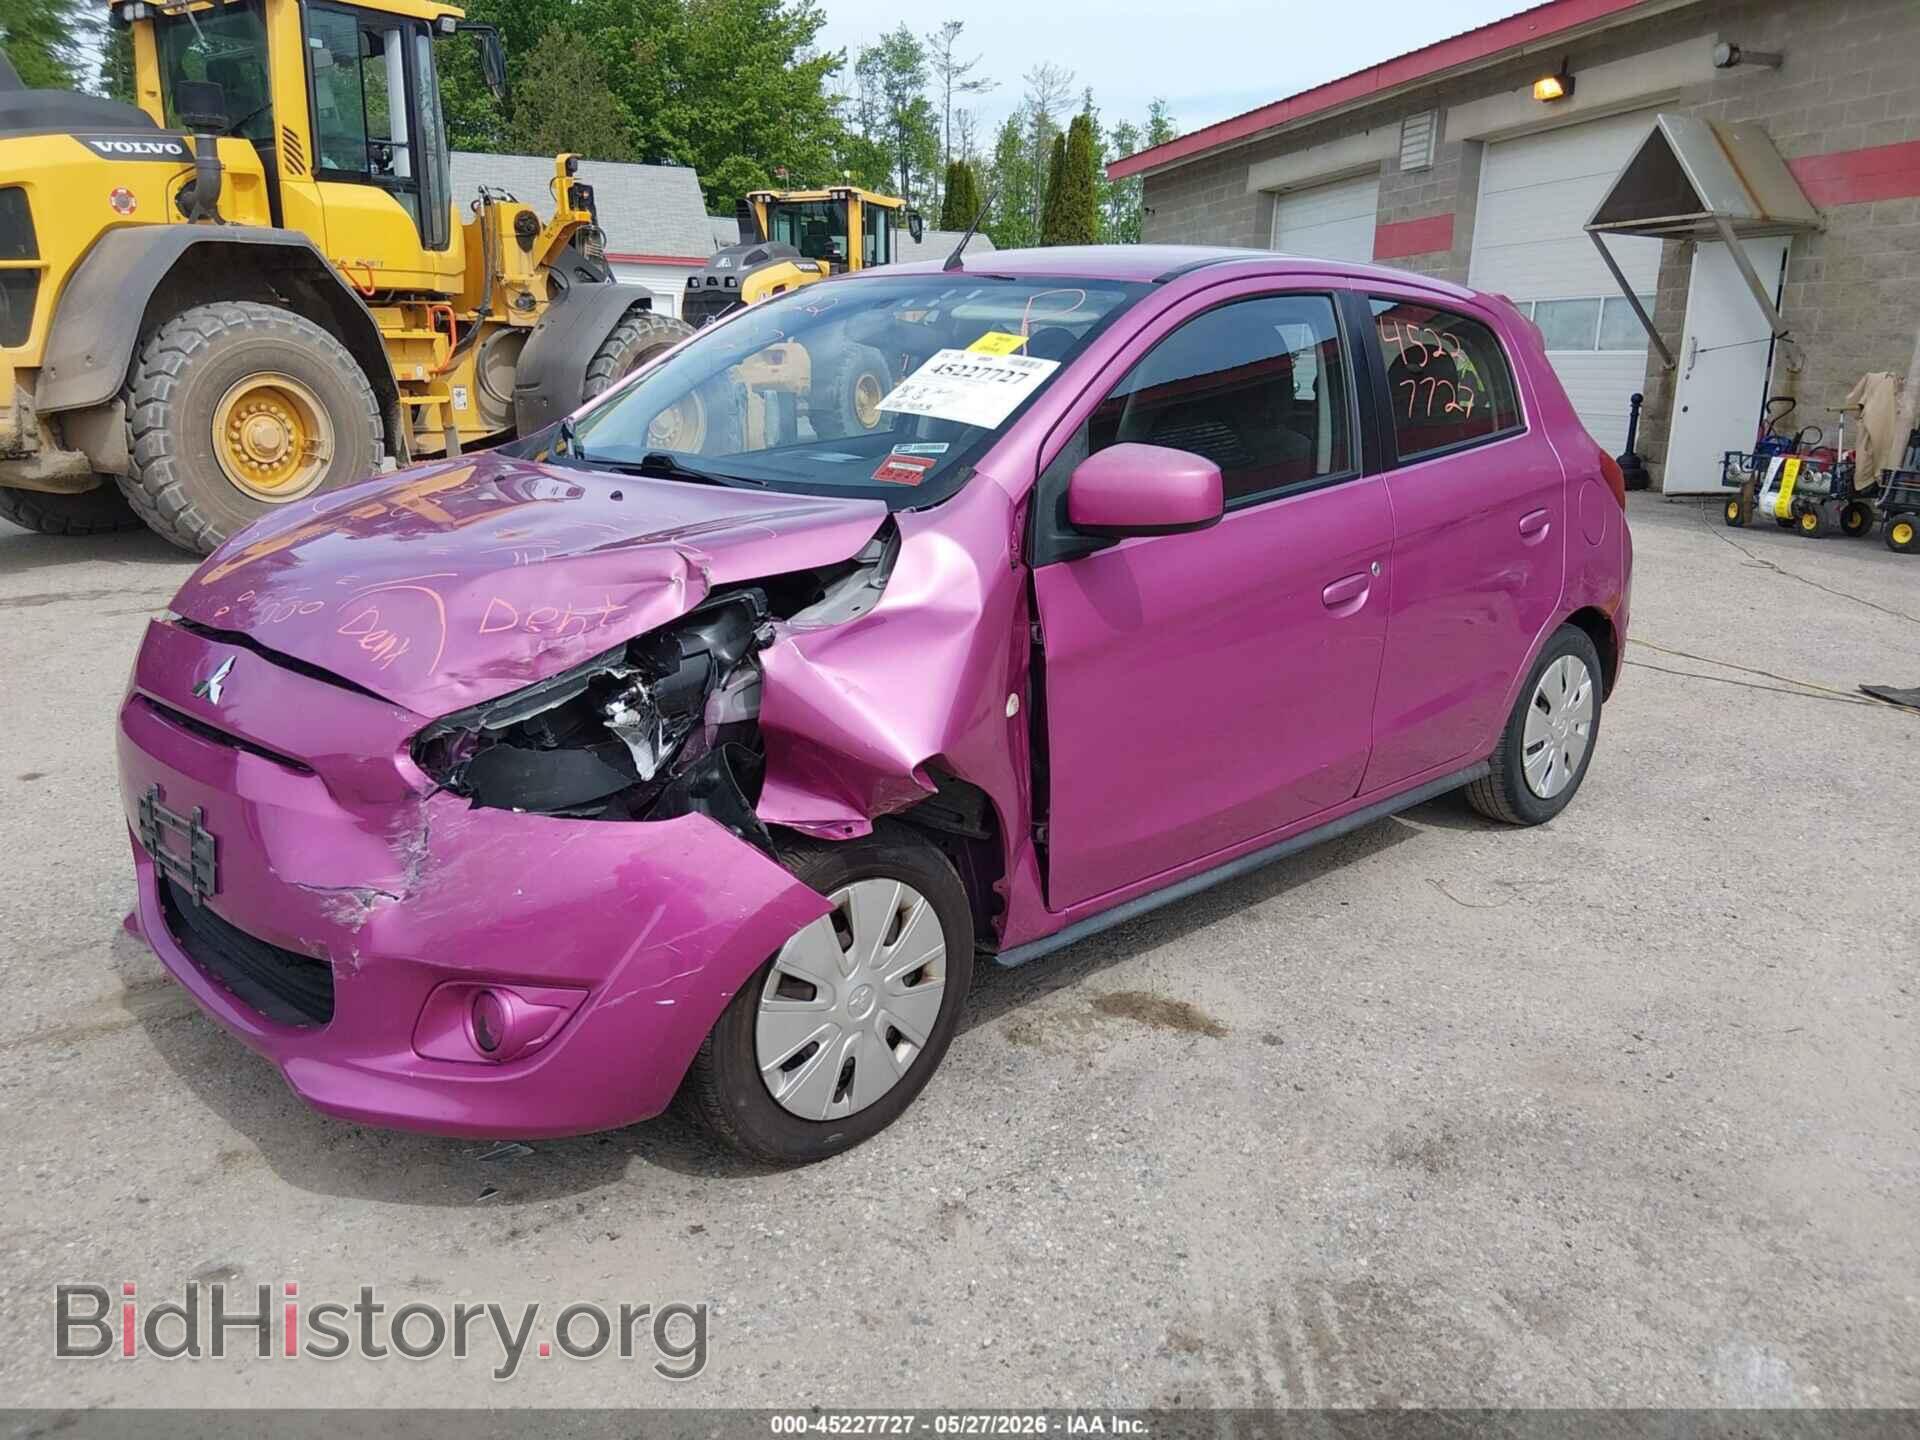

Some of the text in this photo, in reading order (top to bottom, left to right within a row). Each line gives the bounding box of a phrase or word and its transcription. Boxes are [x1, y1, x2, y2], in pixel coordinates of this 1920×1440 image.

[88, 140, 183, 155] VOLVO
[1379, 315, 1462, 368] 4522
[929, 362, 1030, 385] 45227727
[1399, 376, 1475, 419] 7727
[478, 596, 630, 636] Dent
